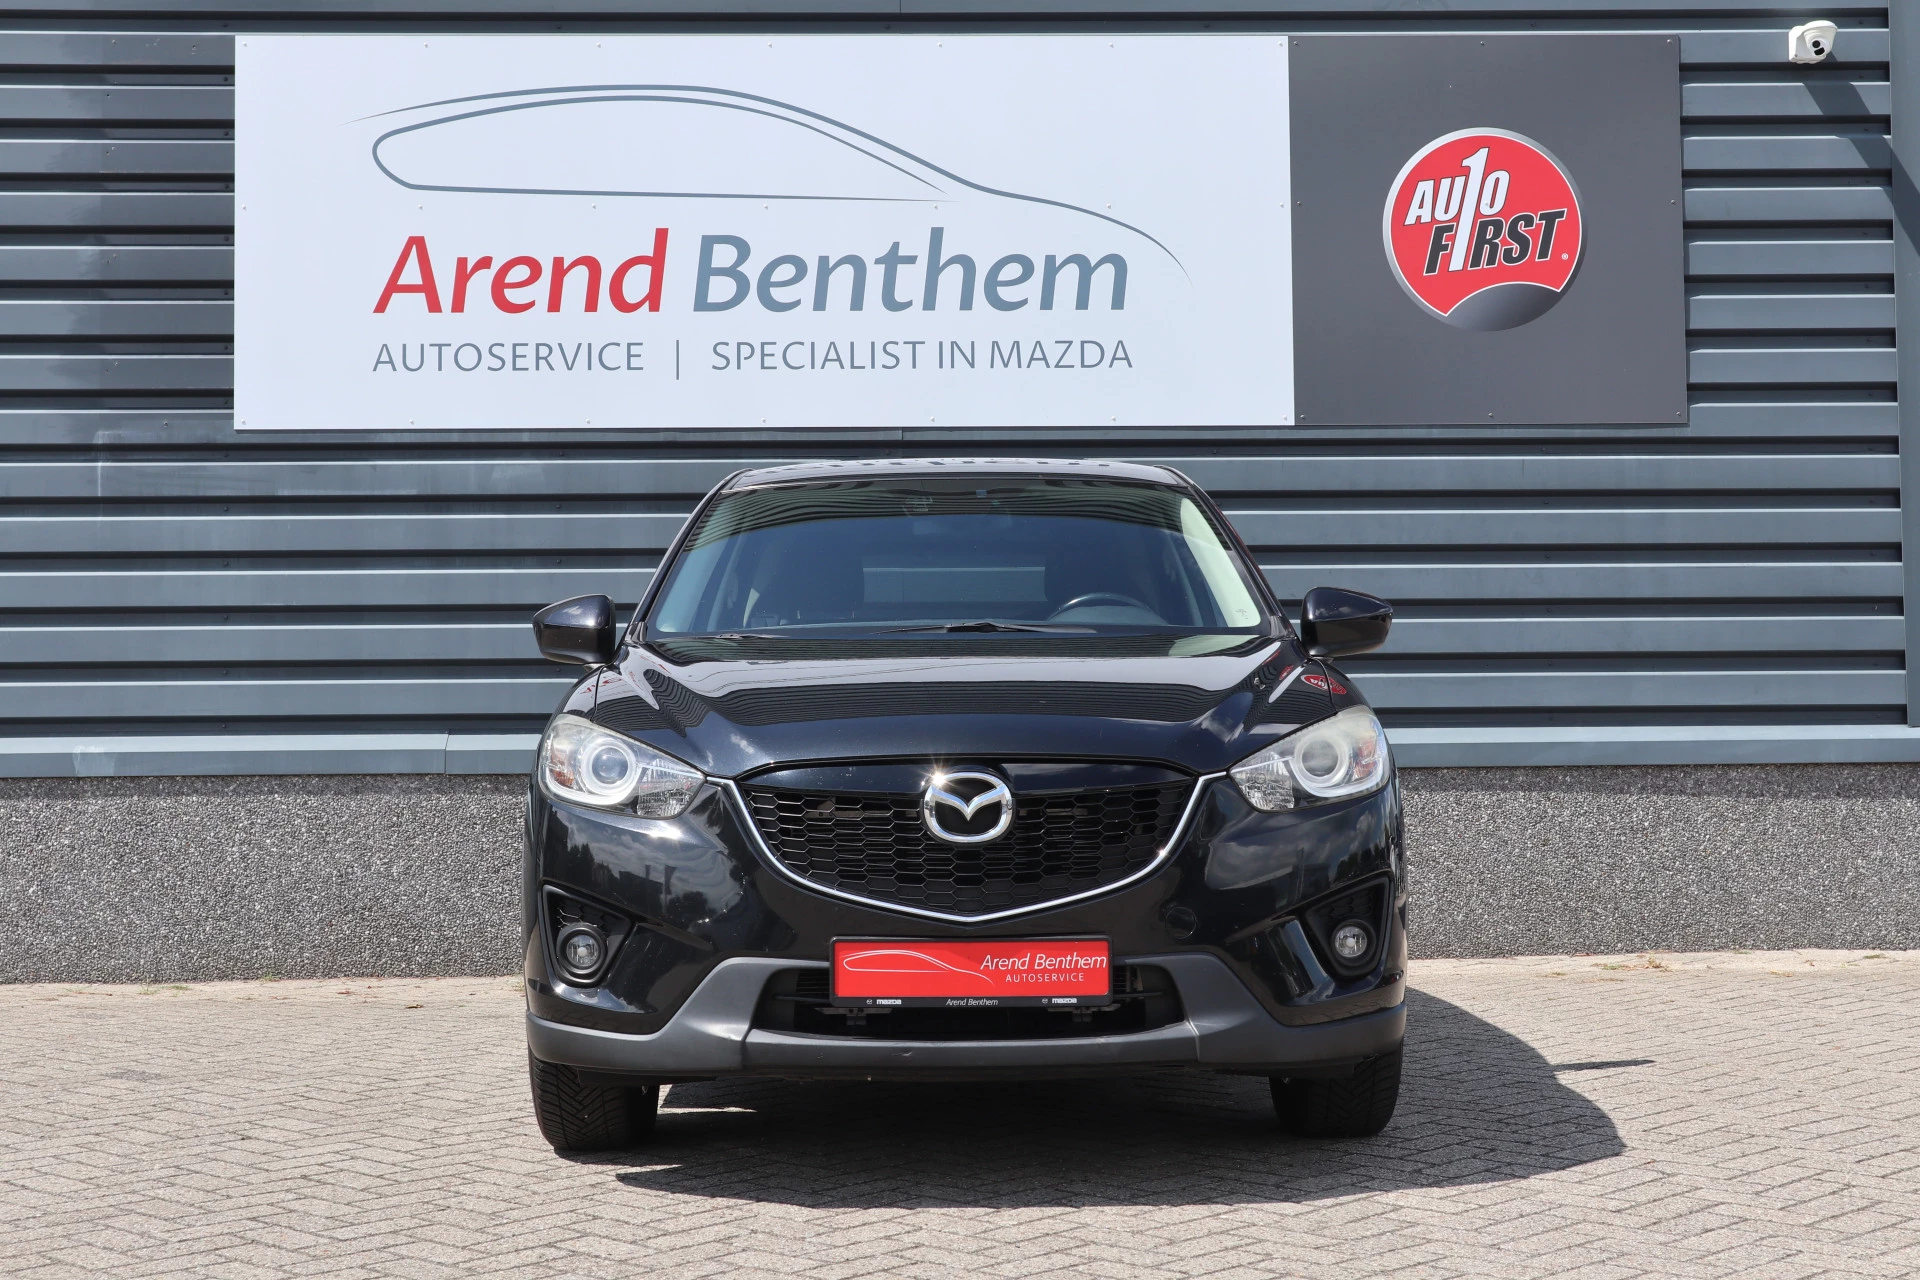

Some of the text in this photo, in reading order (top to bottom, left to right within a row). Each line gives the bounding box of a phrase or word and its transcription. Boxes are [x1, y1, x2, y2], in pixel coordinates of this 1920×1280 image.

[373, 226, 1130, 314] Arend Benthem
[373, 339, 1133, 372] AUTOSERVICE SPECIALIST IN MAZDA
[980, 951, 1107, 970] Arend Benthem
[1005, 972, 1084, 983] AUTOSERVICE
[945, 997, 999, 1007] Arend Benthem
